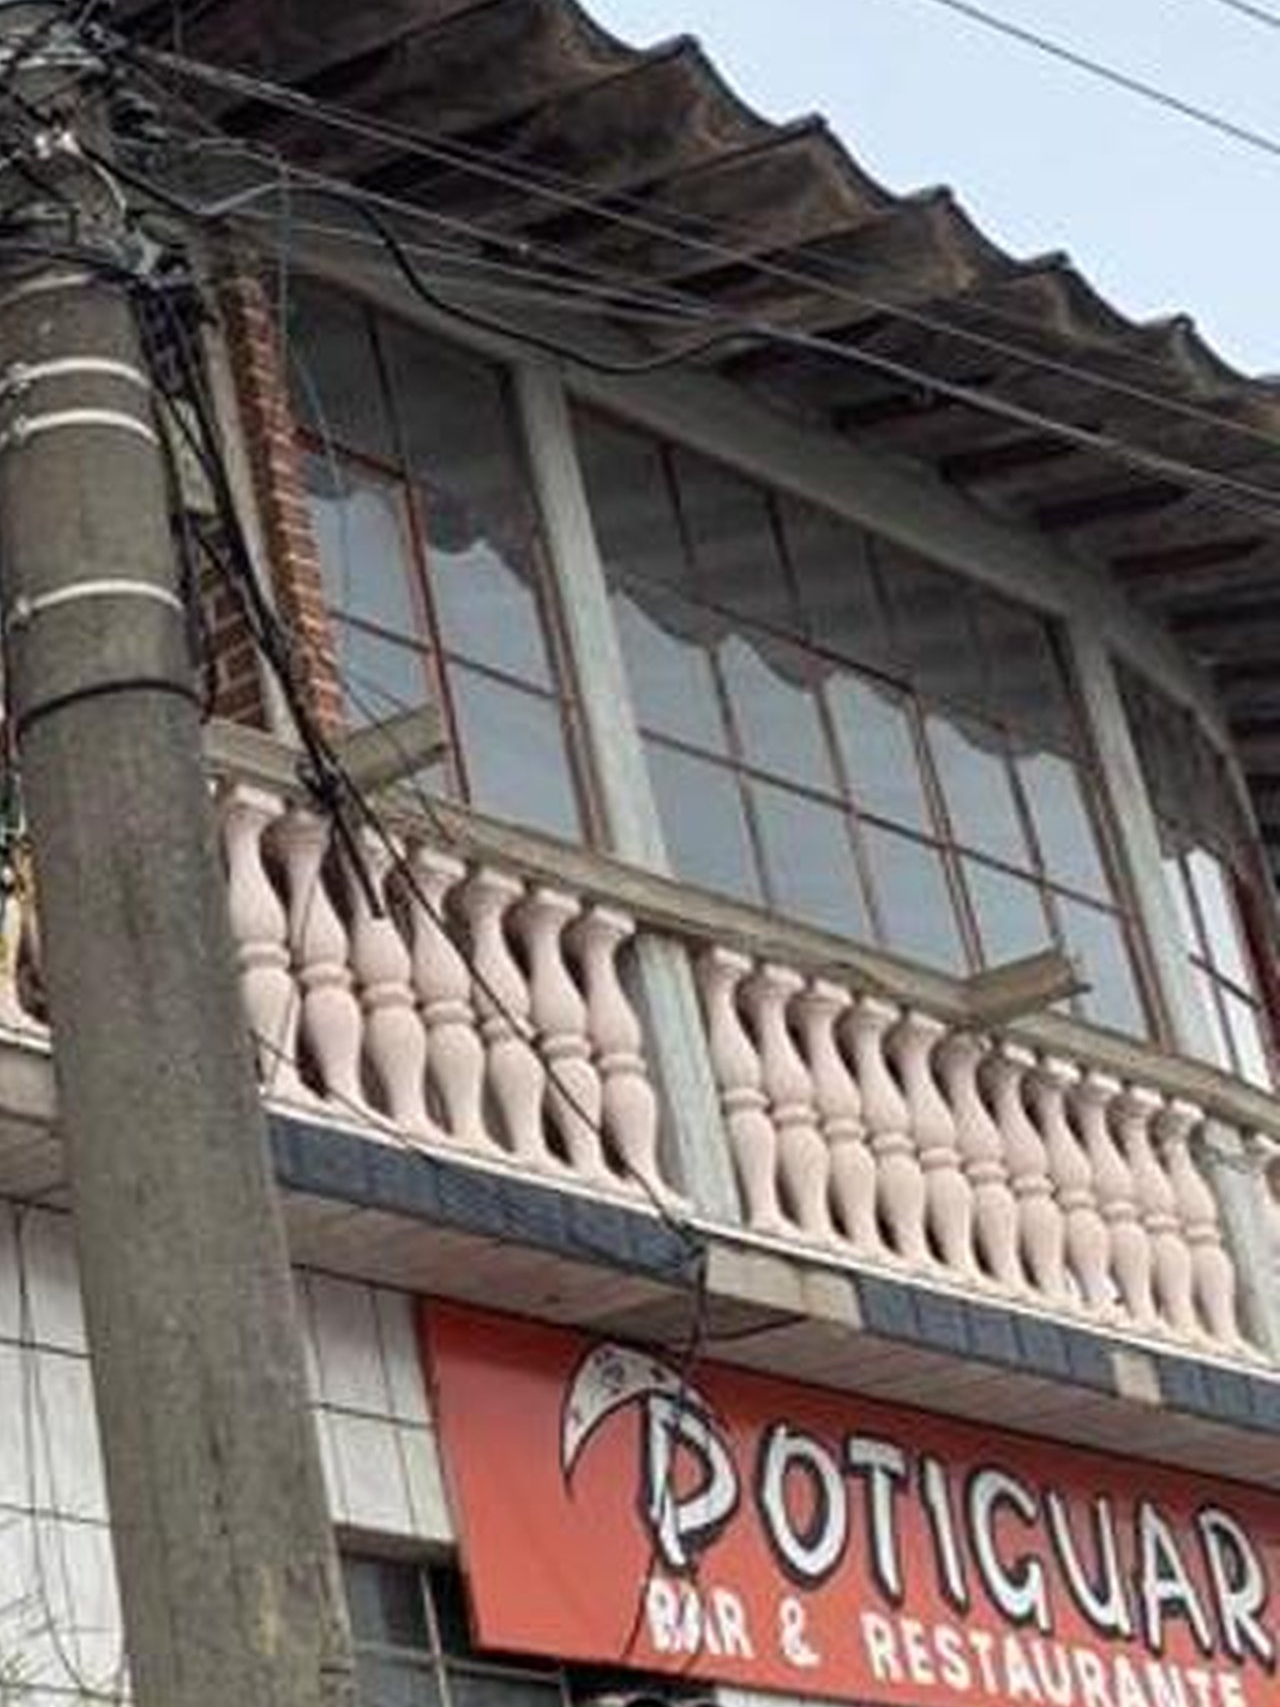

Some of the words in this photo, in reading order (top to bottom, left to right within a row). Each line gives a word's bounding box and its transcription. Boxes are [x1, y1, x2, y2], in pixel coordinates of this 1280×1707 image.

[640, 1379, 1278, 1668] POTIGUAR
[645, 1576, 755, 1659] BAR
[778, 1595, 819, 1667] &
